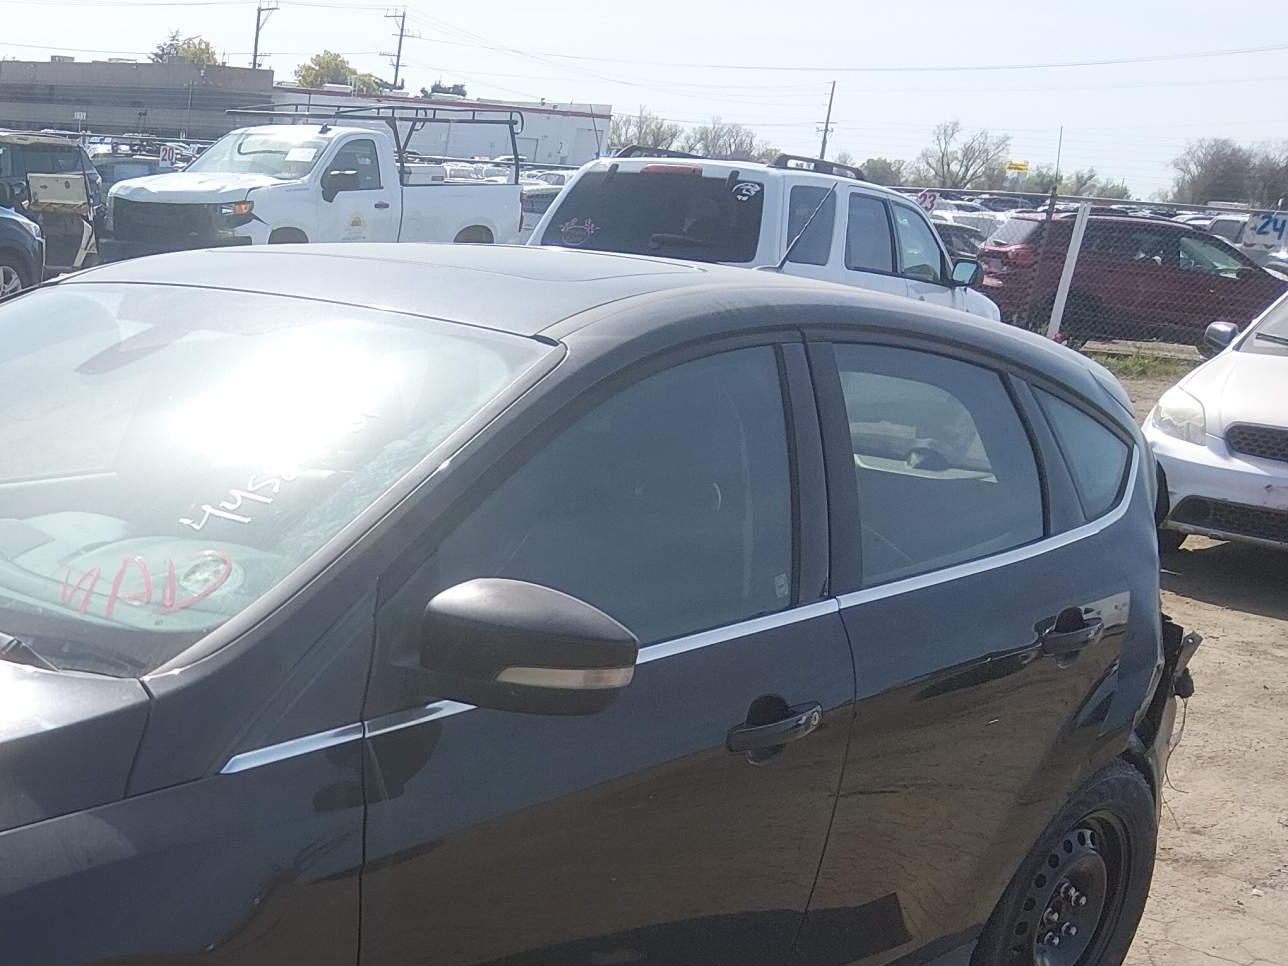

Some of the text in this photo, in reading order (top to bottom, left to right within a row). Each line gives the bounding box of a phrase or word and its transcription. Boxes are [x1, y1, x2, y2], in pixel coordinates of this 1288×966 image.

[161, 148, 174, 161] 20
[919, 193, 936, 210] 23
[1256, 214, 1286, 241] 24
